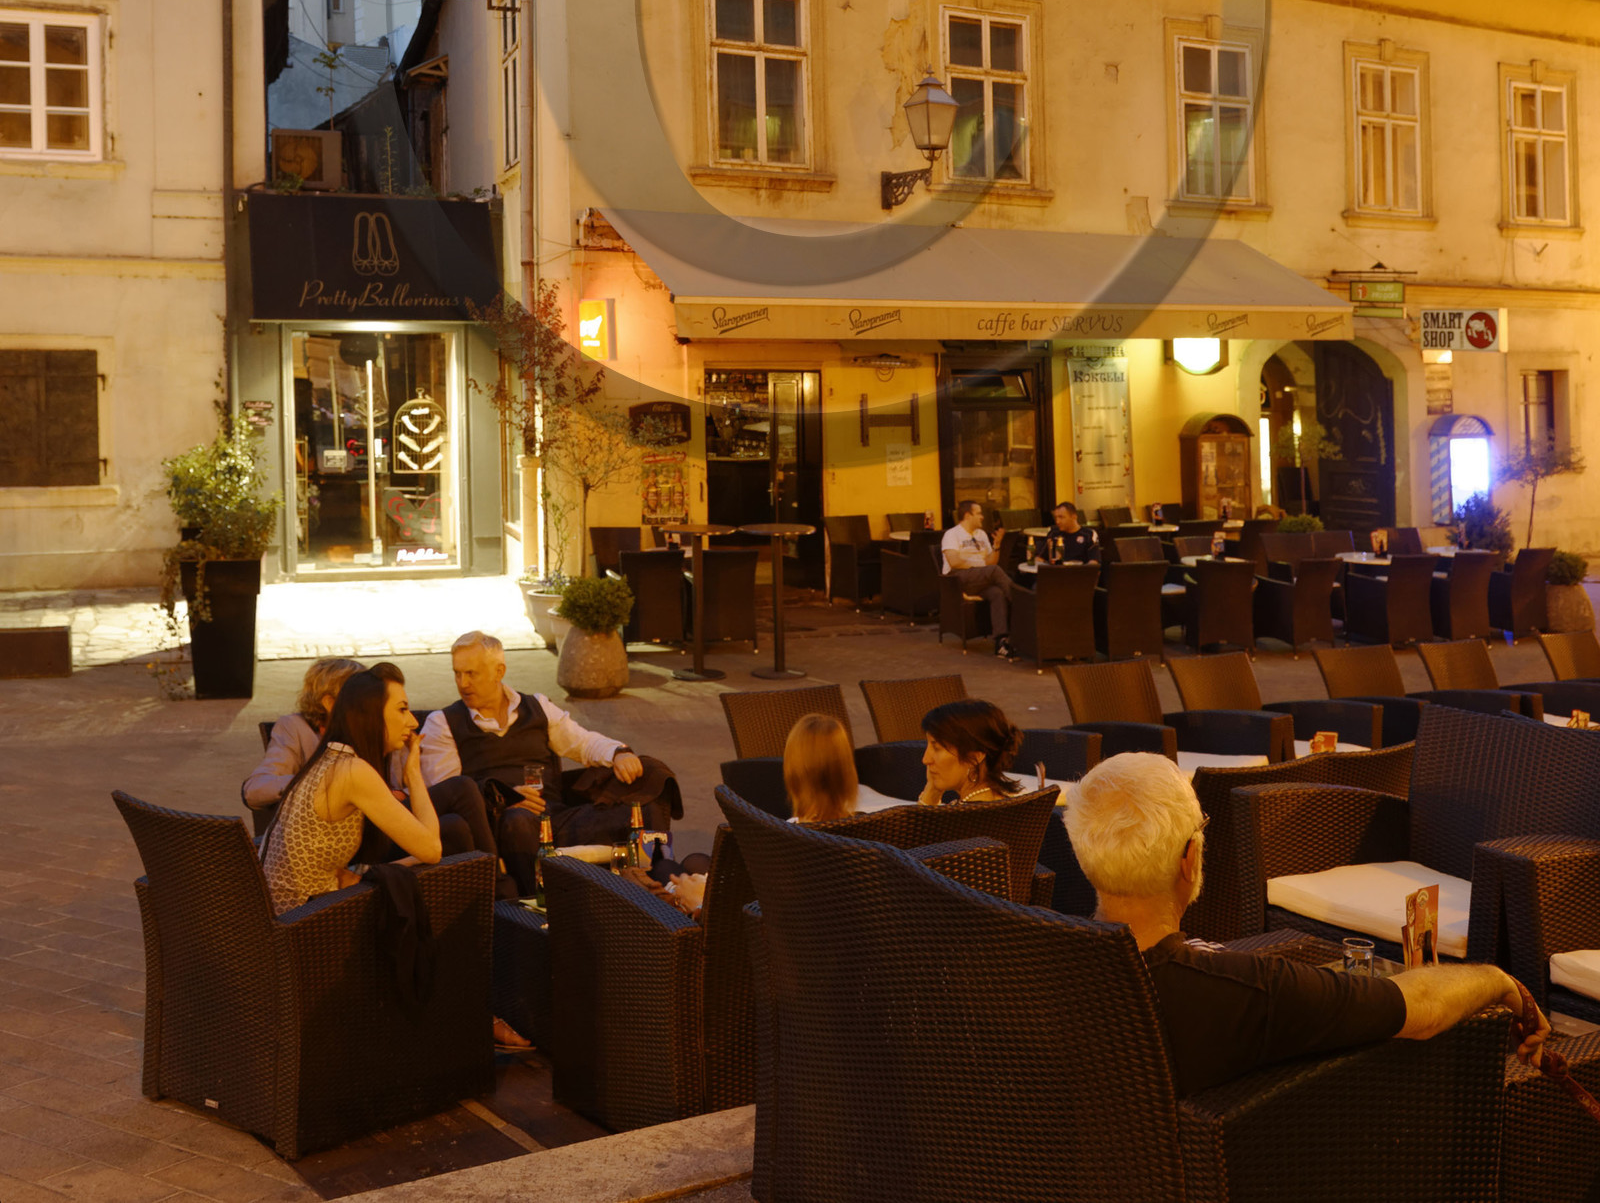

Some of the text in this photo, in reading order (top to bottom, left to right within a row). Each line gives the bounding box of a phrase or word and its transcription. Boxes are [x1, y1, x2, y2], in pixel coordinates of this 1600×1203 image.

[711, 306, 770, 335] Staropramen
[849, 308, 902, 336] Staropramen
[977, 312, 1124, 337] caffe bar SERVUS
[1423, 312, 1464, 329] SMART
[1423, 331, 1455, 348] SHOP
